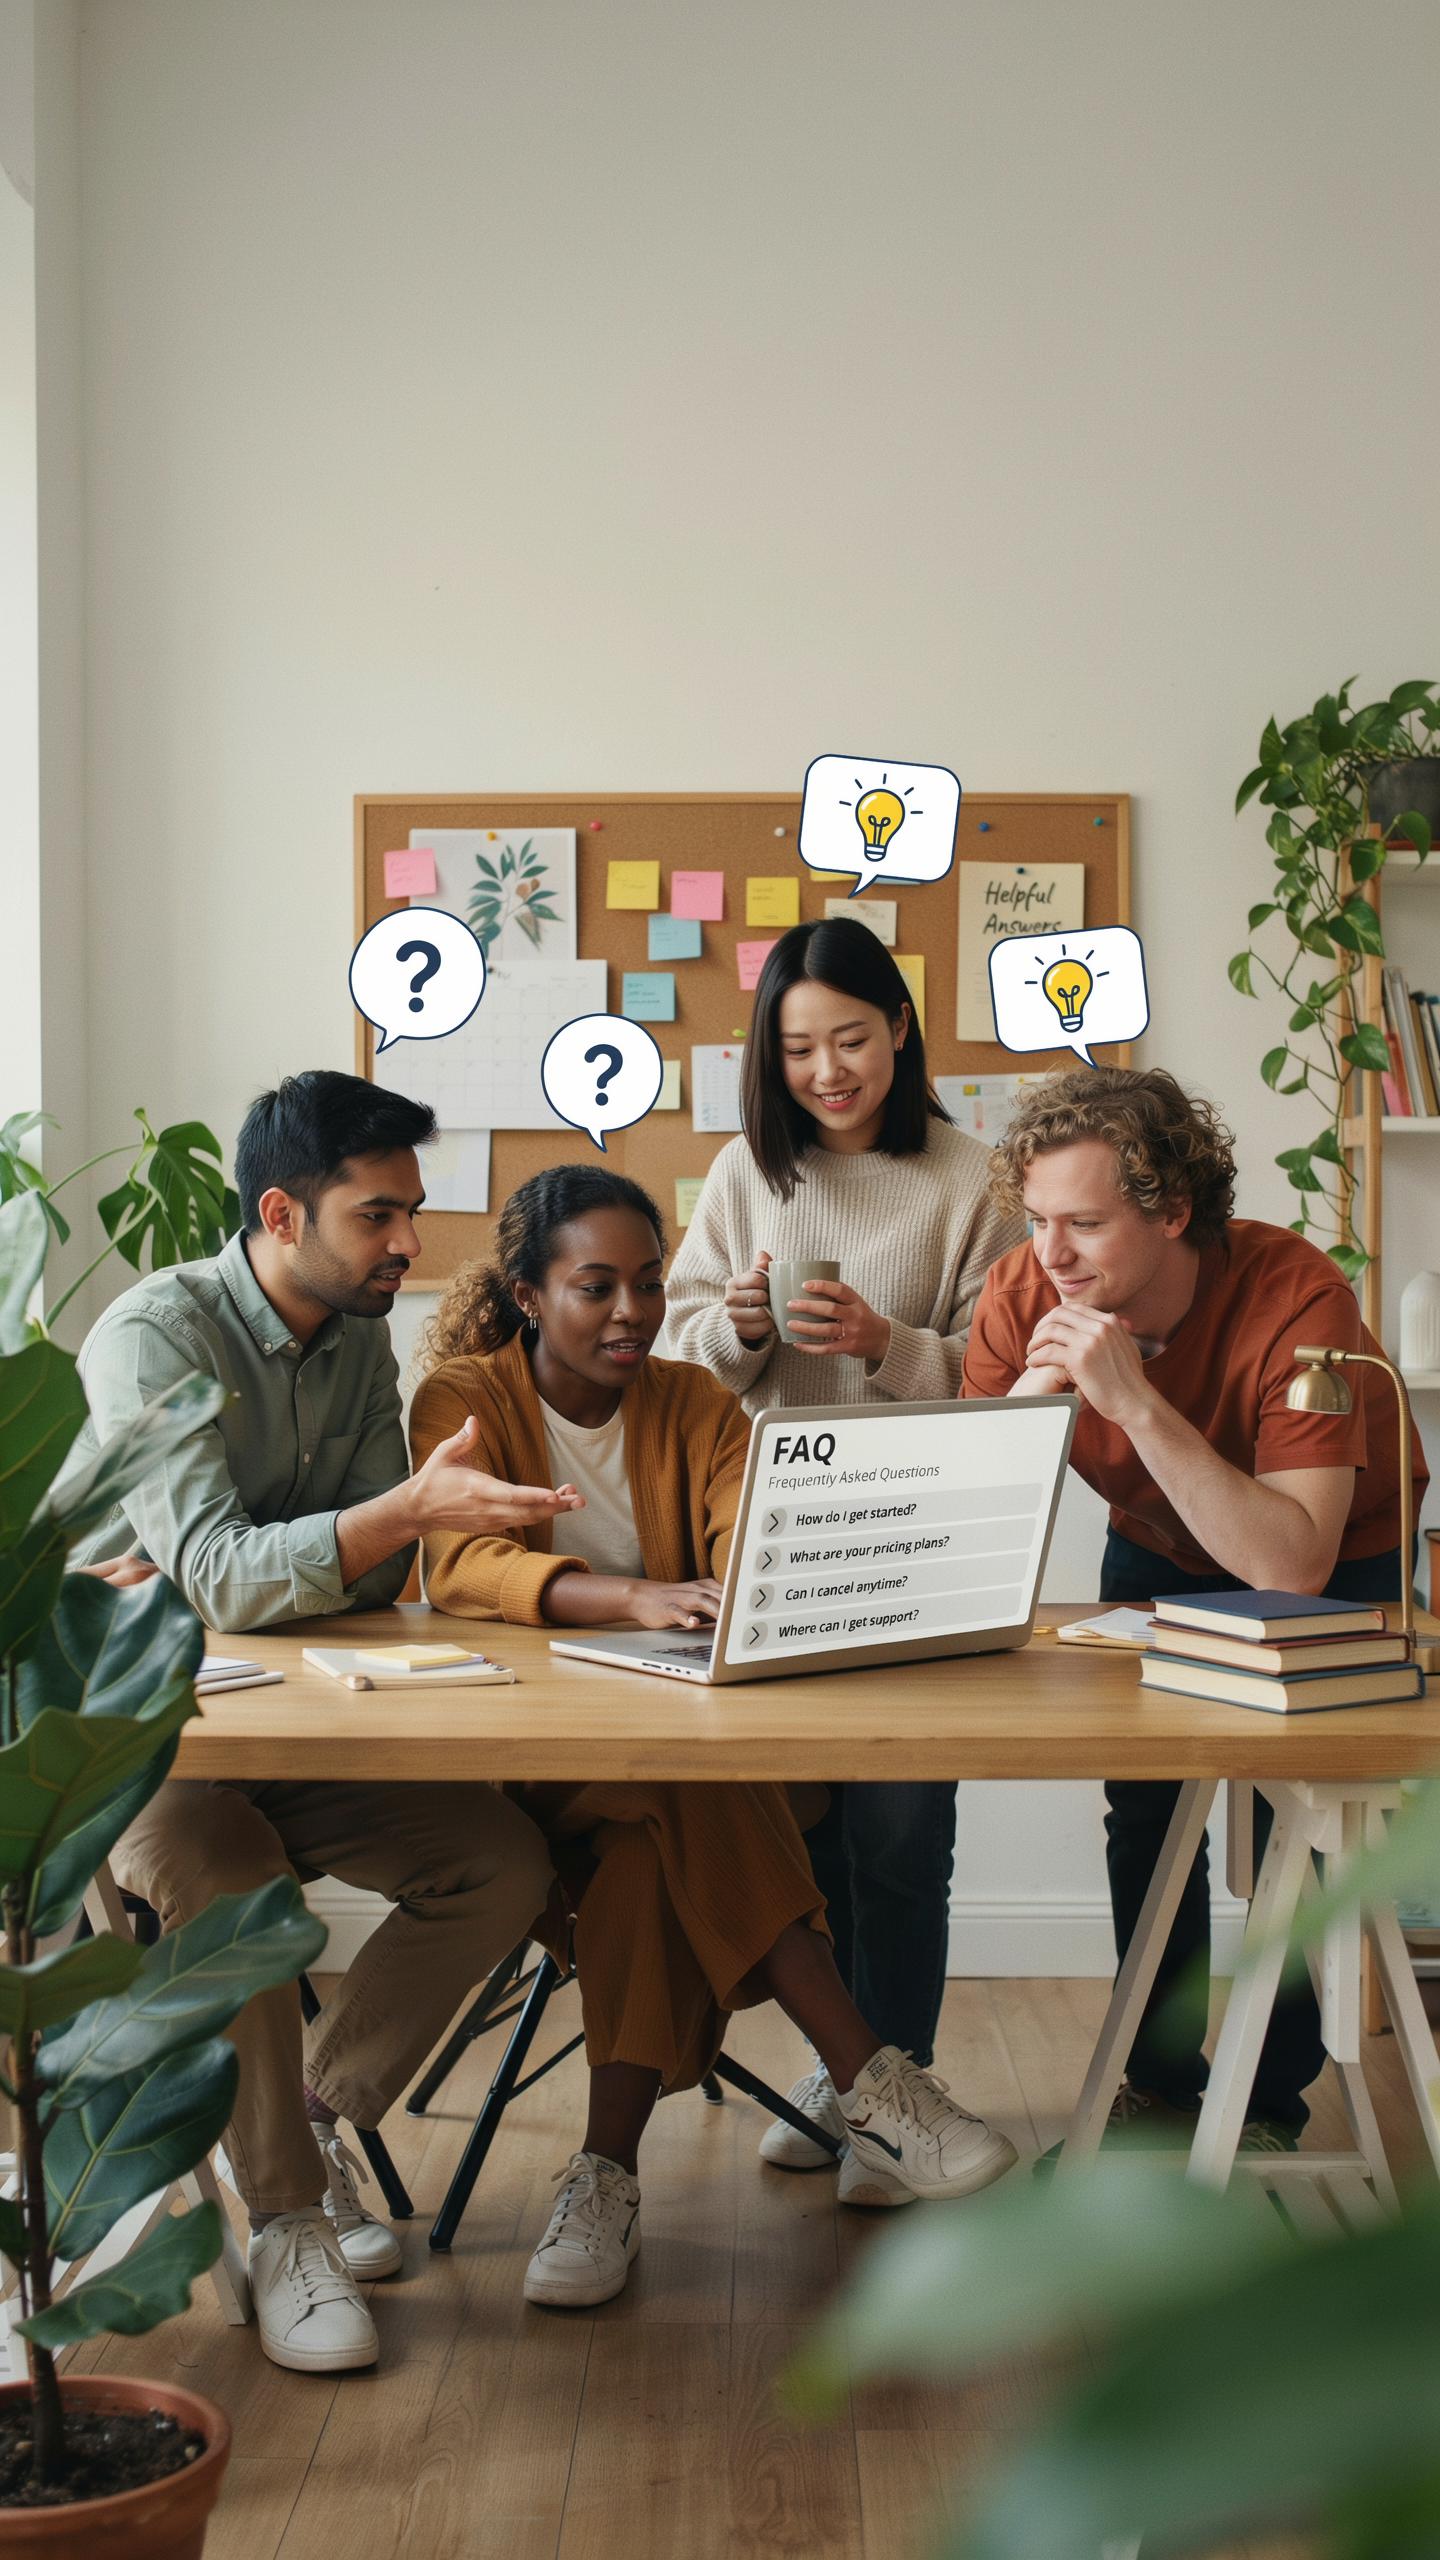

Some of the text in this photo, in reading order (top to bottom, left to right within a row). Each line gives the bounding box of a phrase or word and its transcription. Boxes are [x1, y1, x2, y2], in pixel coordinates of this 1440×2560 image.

[984, 881, 1056, 912] Helpful
[982, 913, 1062, 935] Answers
[773, 1433, 836, 1466] FAQ
[839, 1468, 877, 1484] Asked
[880, 1465, 940, 1482] Questions
[796, 1503, 917, 1526] How do I get started?
[790, 1536, 950, 1564] What are your pricing plans?
[785, 1575, 908, 1600] Can I cancel anytime?
[779, 1609, 919, 1638] Where can I get support?
